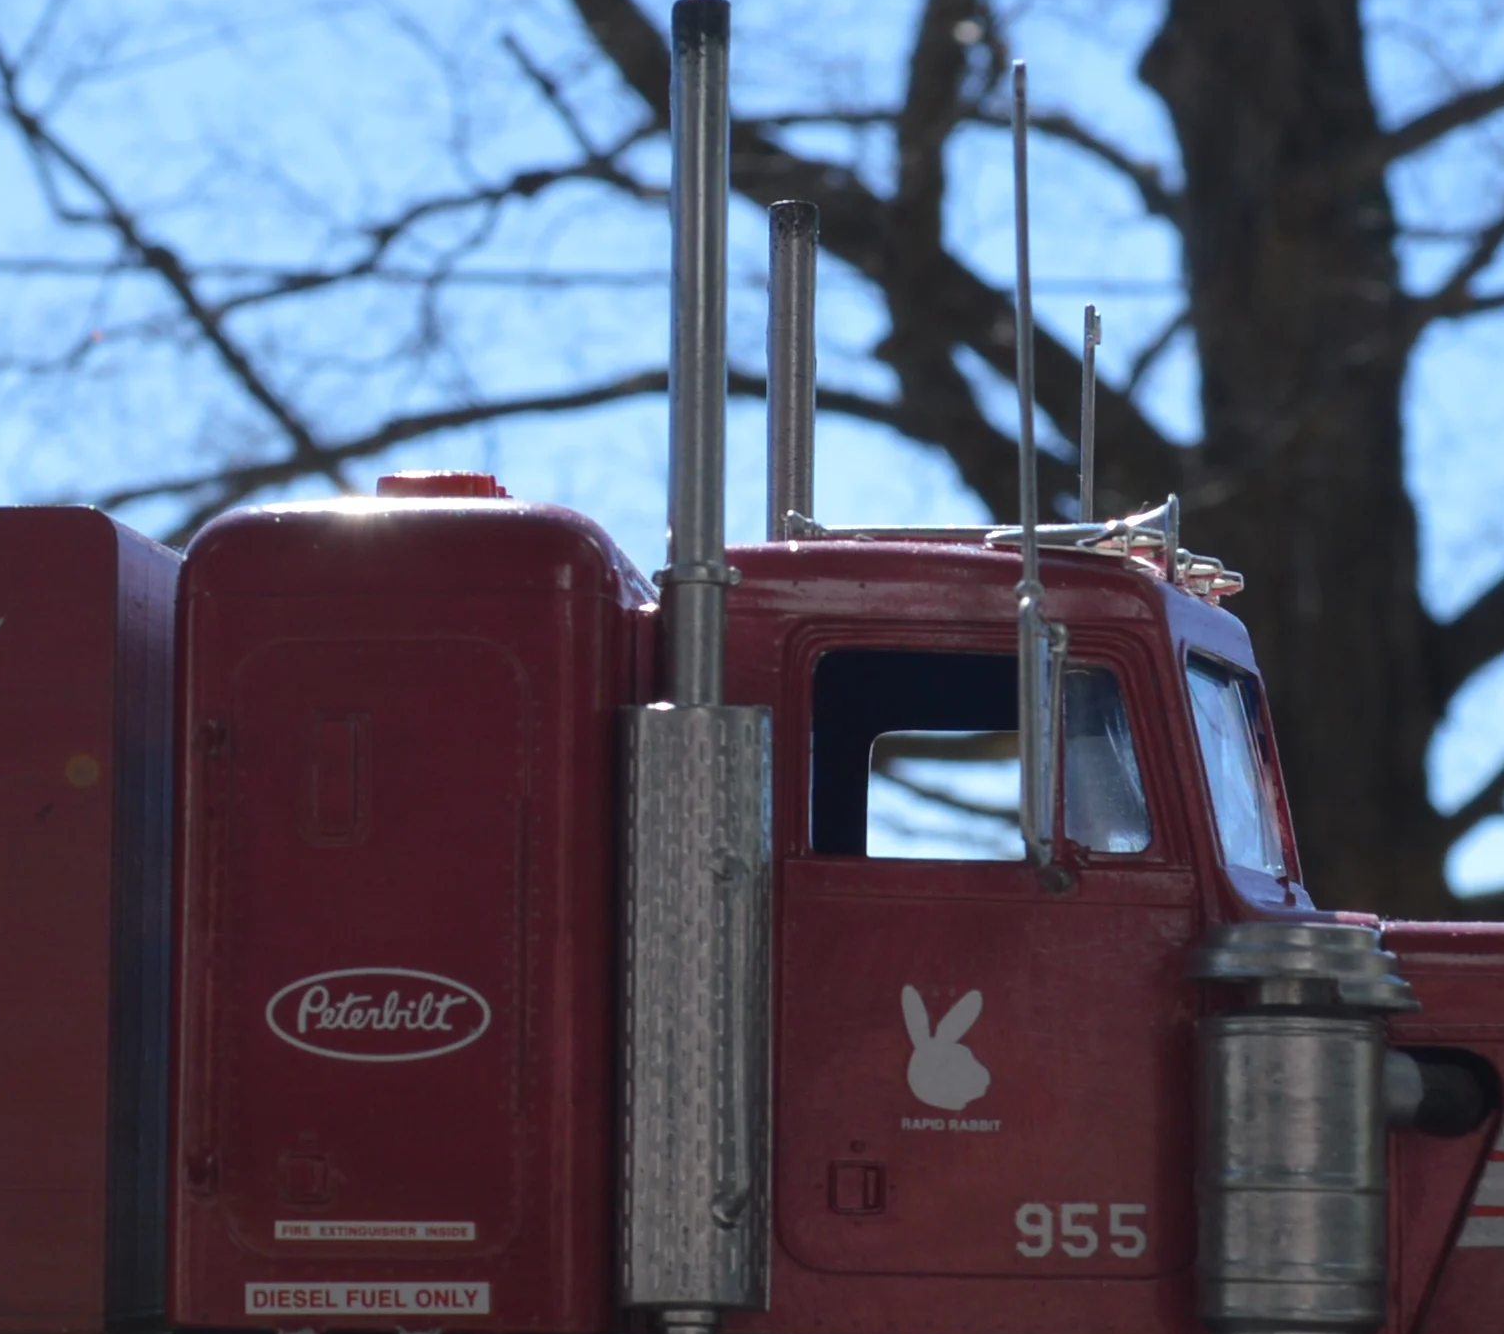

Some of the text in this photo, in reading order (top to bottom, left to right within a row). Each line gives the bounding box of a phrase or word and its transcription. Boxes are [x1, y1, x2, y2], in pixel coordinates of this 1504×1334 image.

[298, 985, 468, 1034] Peterbilt
[901, 1117, 1001, 1132] RAPID RABBIT
[281, 1225, 469, 1238] FIRE EXTINGUISHER INSIDE
[1016, 1203, 1146, 1258] 955
[253, 1289, 479, 1308] DIESEL FUEL ONLY
